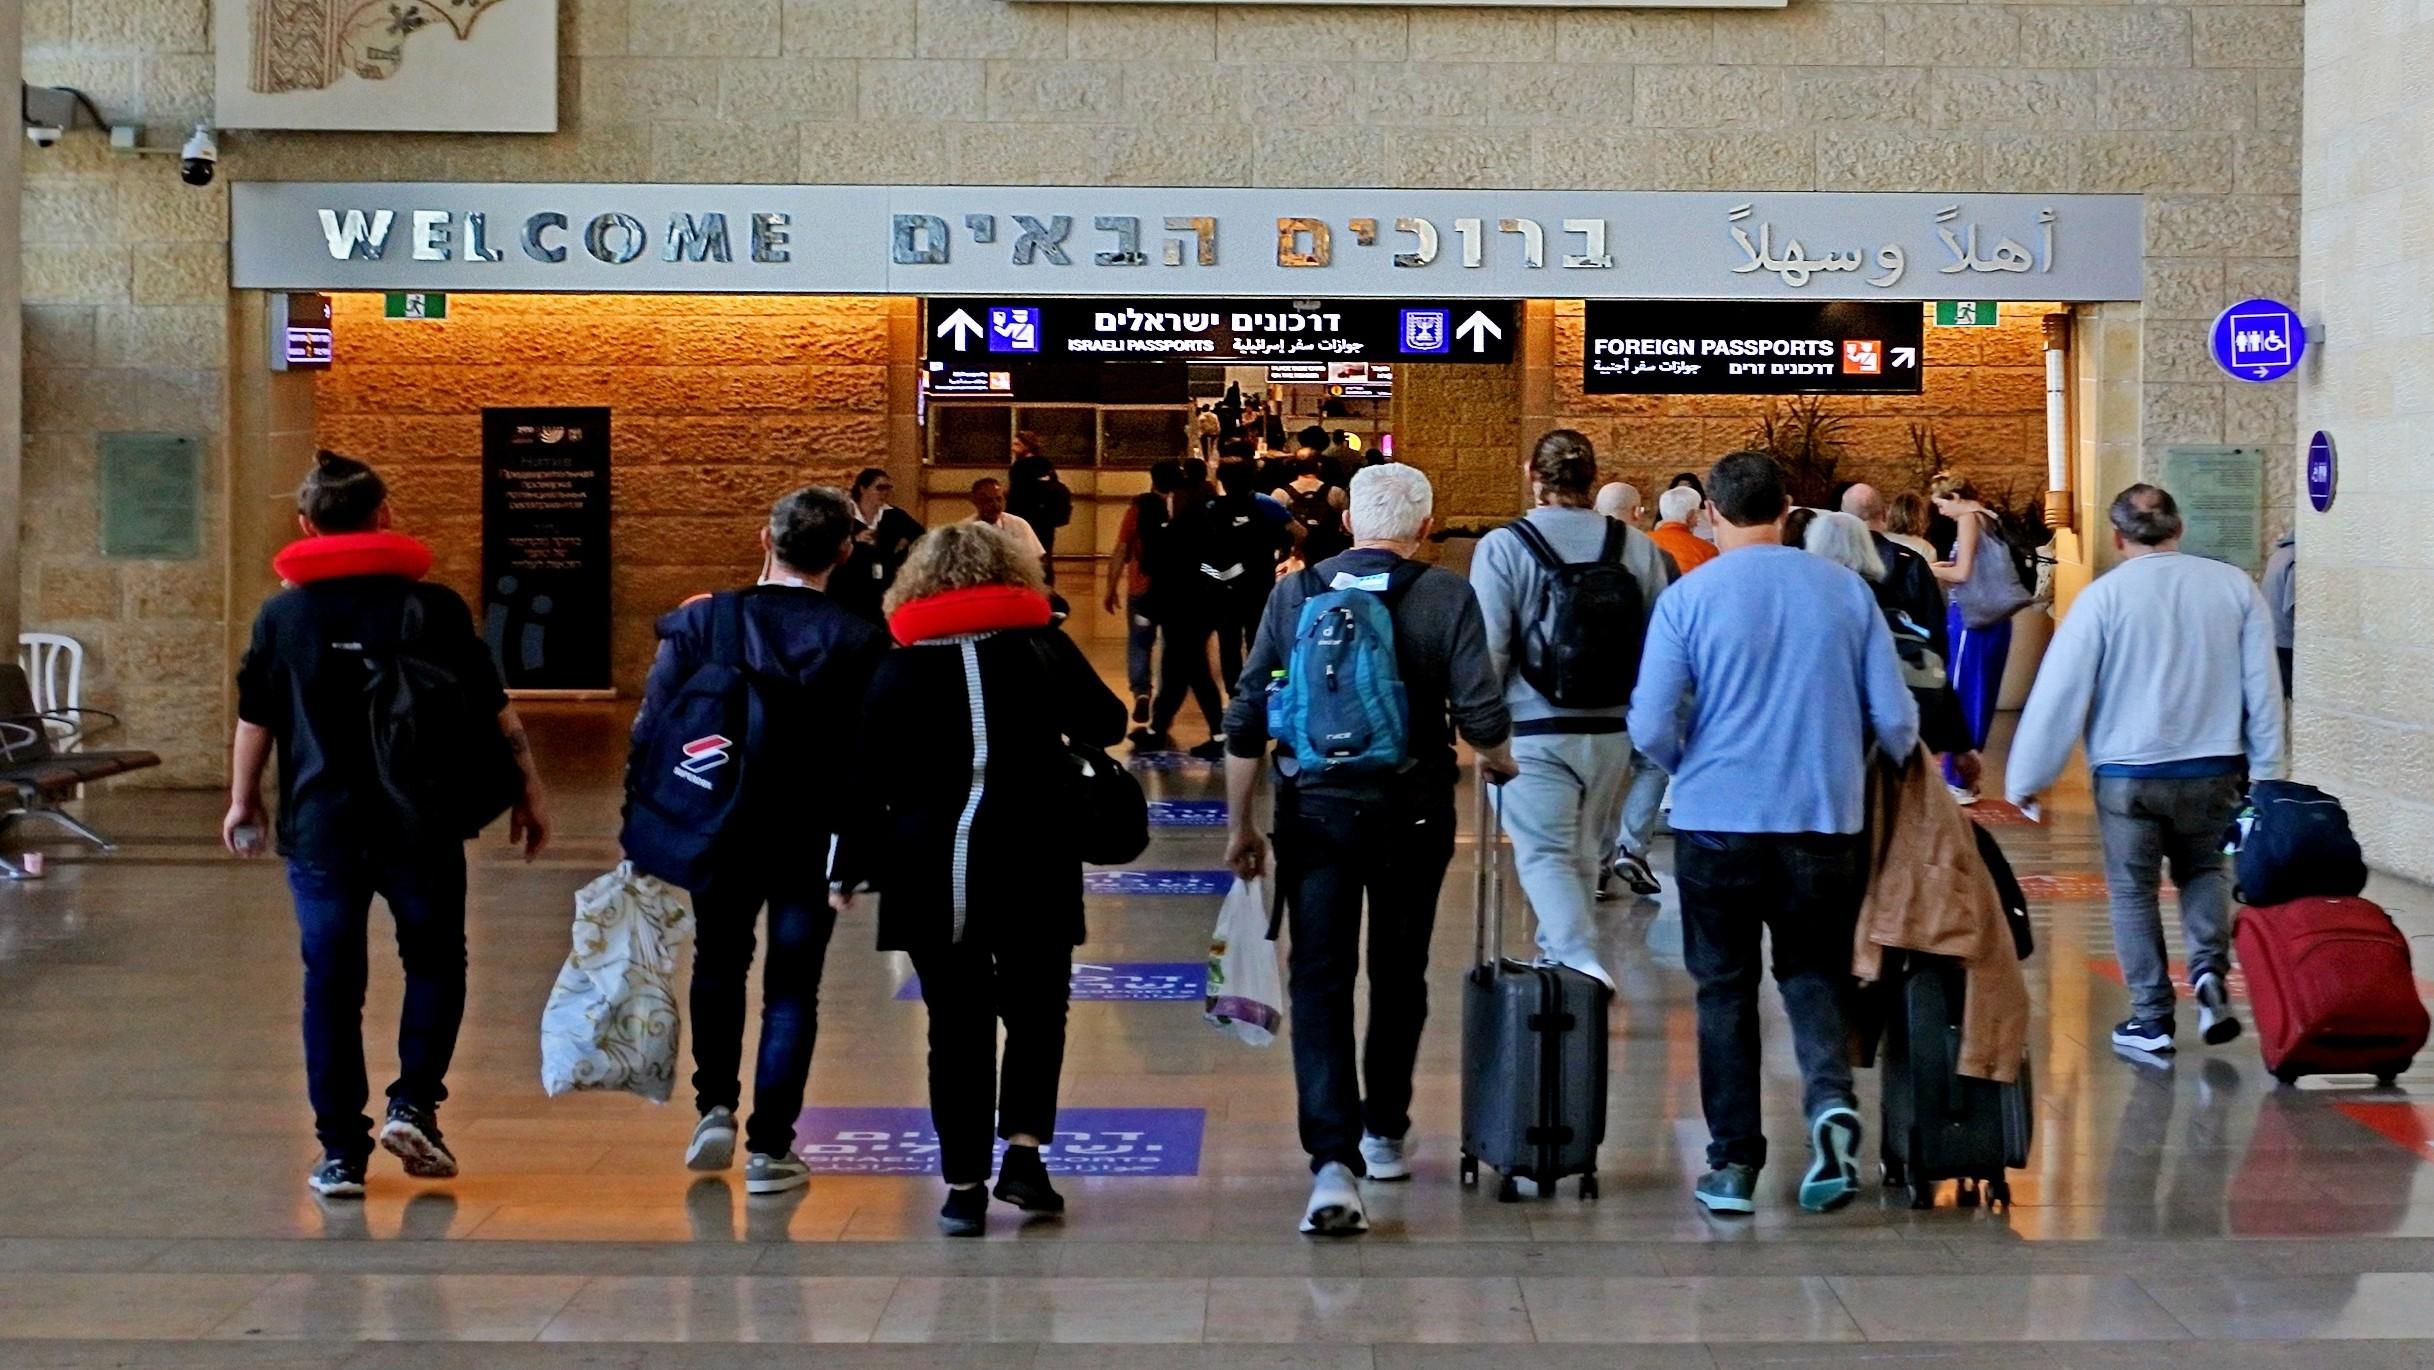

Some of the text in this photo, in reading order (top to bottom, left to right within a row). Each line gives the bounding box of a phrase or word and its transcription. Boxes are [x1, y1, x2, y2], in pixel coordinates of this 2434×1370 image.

[318, 208, 792, 263] WELCOME
[892, 214, 1616, 269] ברוכים הבאים
[1094, 307, 1341, 332] דרכונים ישראלים
[1067, 339, 1215, 352] ISRAELI PASSPORTS
[1287, 338, 1315, 354] سفر
[1318, 338, 1365, 354] جوازات
[1594, 338, 1834, 356] FOREIGN PASSPORTS
[1631, 360, 1656, 375] سفر
[1658, 359, 1702, 375] جوازات
[1728, 362, 1835, 375] דרכונים זרים
